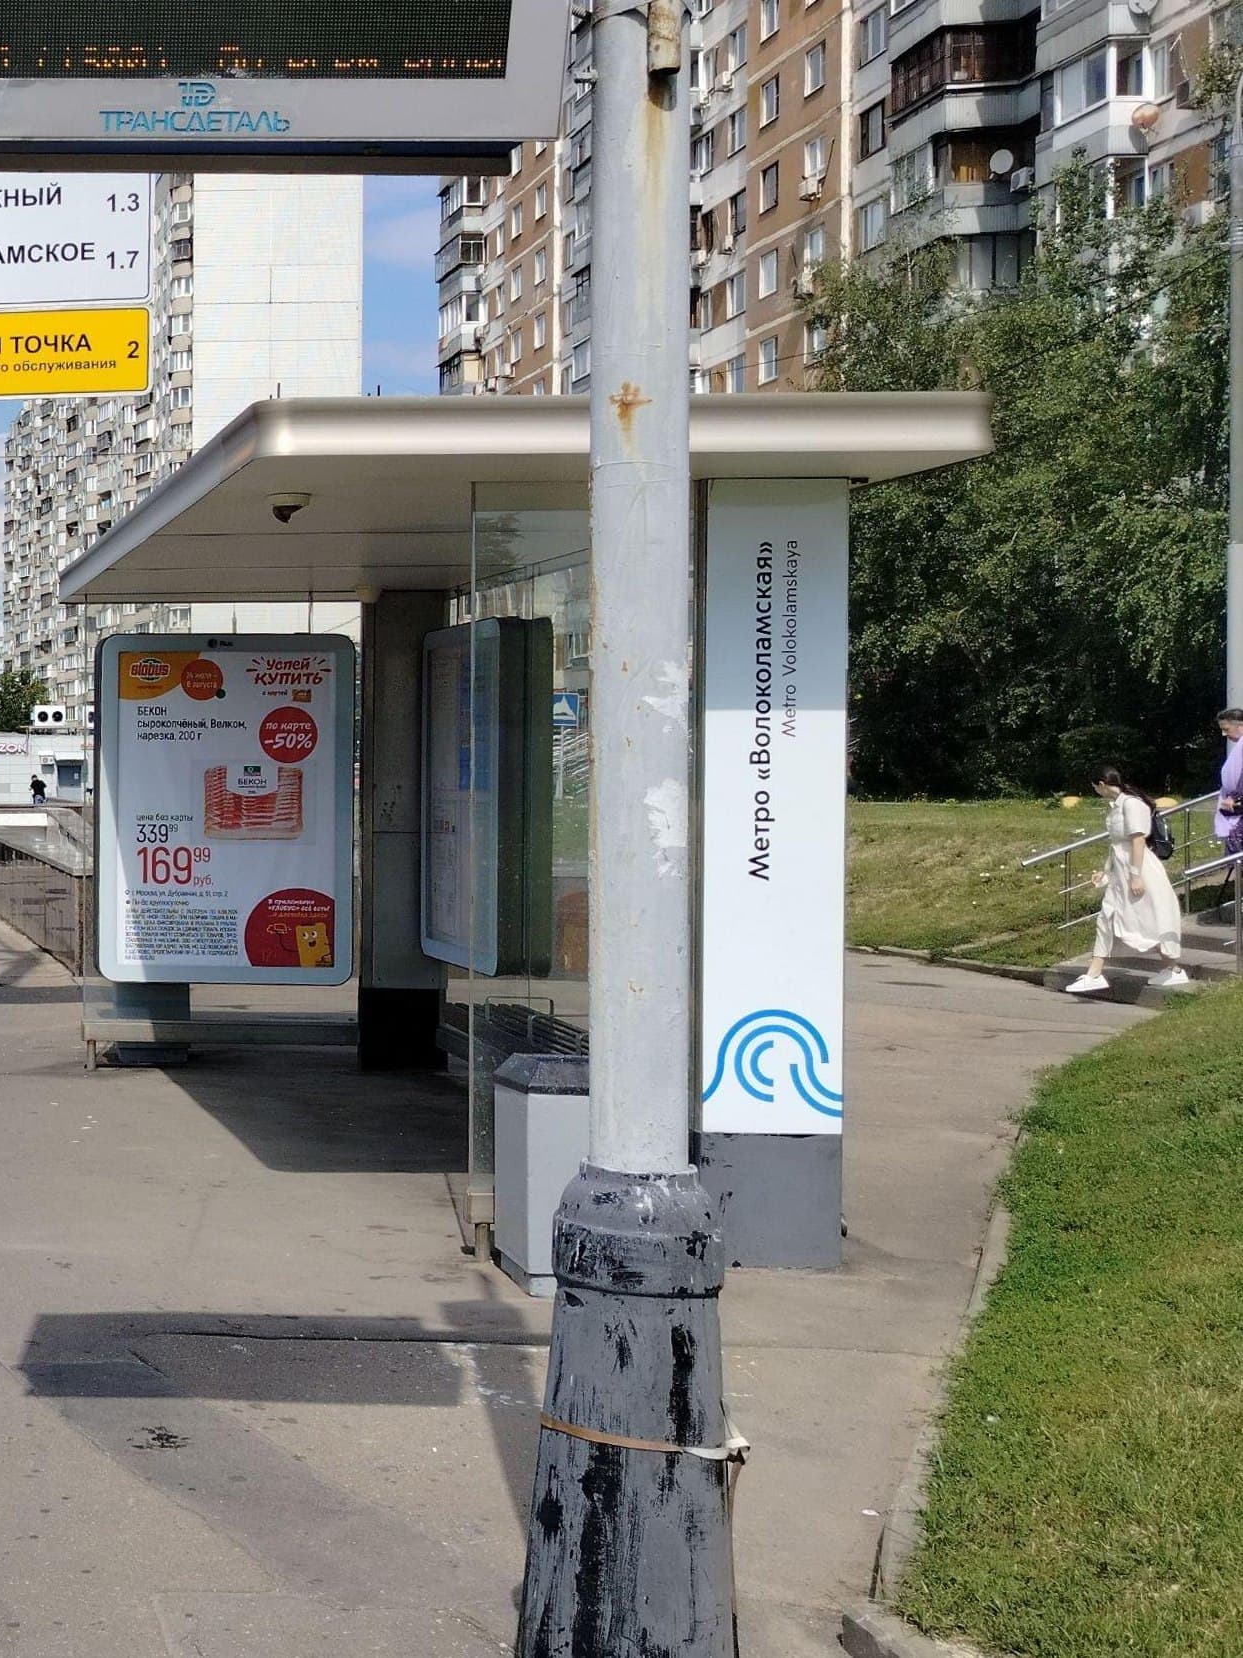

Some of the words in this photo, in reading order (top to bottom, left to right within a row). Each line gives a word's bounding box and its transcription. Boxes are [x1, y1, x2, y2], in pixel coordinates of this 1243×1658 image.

[99, 111, 291, 132] ТРАНСДЕТАЛЬ
[106, 193, 140, 212] 1.3
[106, 251, 140, 270] 1.7
[10, 333, 92, 354] ТОЧКА
[127, 341, 140, 359] 2
[13, 359, 116, 373] обслуживания
[782, 540, 799, 678] Volokolamskaya
[749, 541, 773, 780] «Волоколамская»
[137, 706, 167, 716] БЕКОН
[782, 684, 797, 738] Metro
[137, 732, 176, 741] нарезка,
[178, 731, 195, 740] 200
[197, 732, 202, 740] г
[280, 722, 312, 731] карте
[136, 824, 169, 843] 339
[748, 791, 775, 881] Метро
[137, 846, 192, 885] 169
[193, 874, 214, 887] руб.
